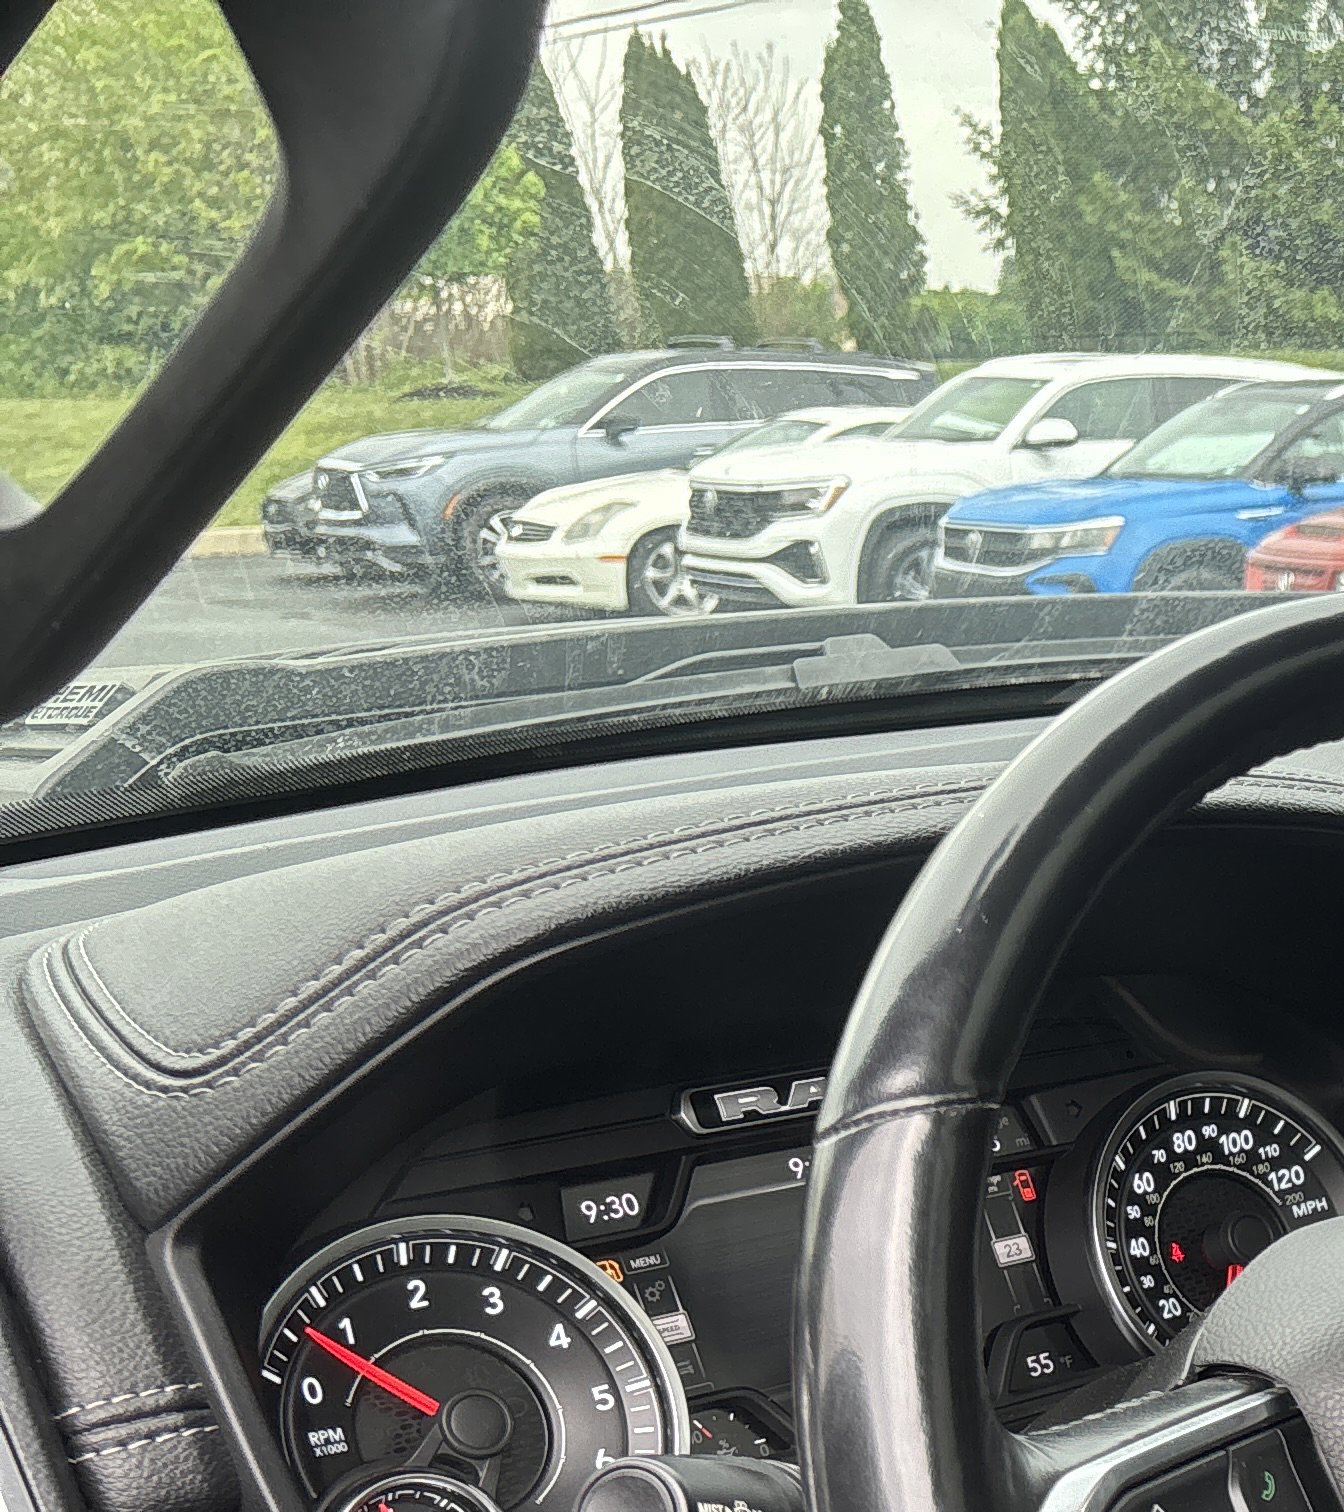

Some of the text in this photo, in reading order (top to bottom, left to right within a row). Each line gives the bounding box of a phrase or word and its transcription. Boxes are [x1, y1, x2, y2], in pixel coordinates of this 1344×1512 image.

[713, 1076, 826, 1122] RA
[1172, 1129, 1196, 1154] 80
[1201, 1123, 1218, 1140] 90
[1218, 1129, 1253, 1155] 100
[1151, 1149, 1167, 1164] 70
[1258, 1143, 1280, 1160] 110
[1133, 1172, 1155, 1194] 60
[1267, 1164, 1305, 1191] 120
[580, 1193, 639, 1224] 9:30
[1126, 1205, 1141, 1219] 50
[1291, 1196, 1328, 1219] MPH
[1004, 1242, 1022, 1259] 23
[1130, 1237, 1149, 1258] 40
[630, 1253, 661, 1270] MENU
[1140, 1274, 1155, 1289] 30
[405, 1279, 429, 1309] 2
[482, 1286, 504, 1315] 3
[1158, 1297, 1182, 1319] 20
[338, 1317, 357, 1346] 1
[549, 1322, 573, 1350] 4
[1026, 1352, 1054, 1377] 55
[300, 1376, 324, 1405] 0
[592, 1384, 615, 1411] 5
[307, 1426, 346, 1446] RPM
[314, 1441, 349, 1458] X1000
